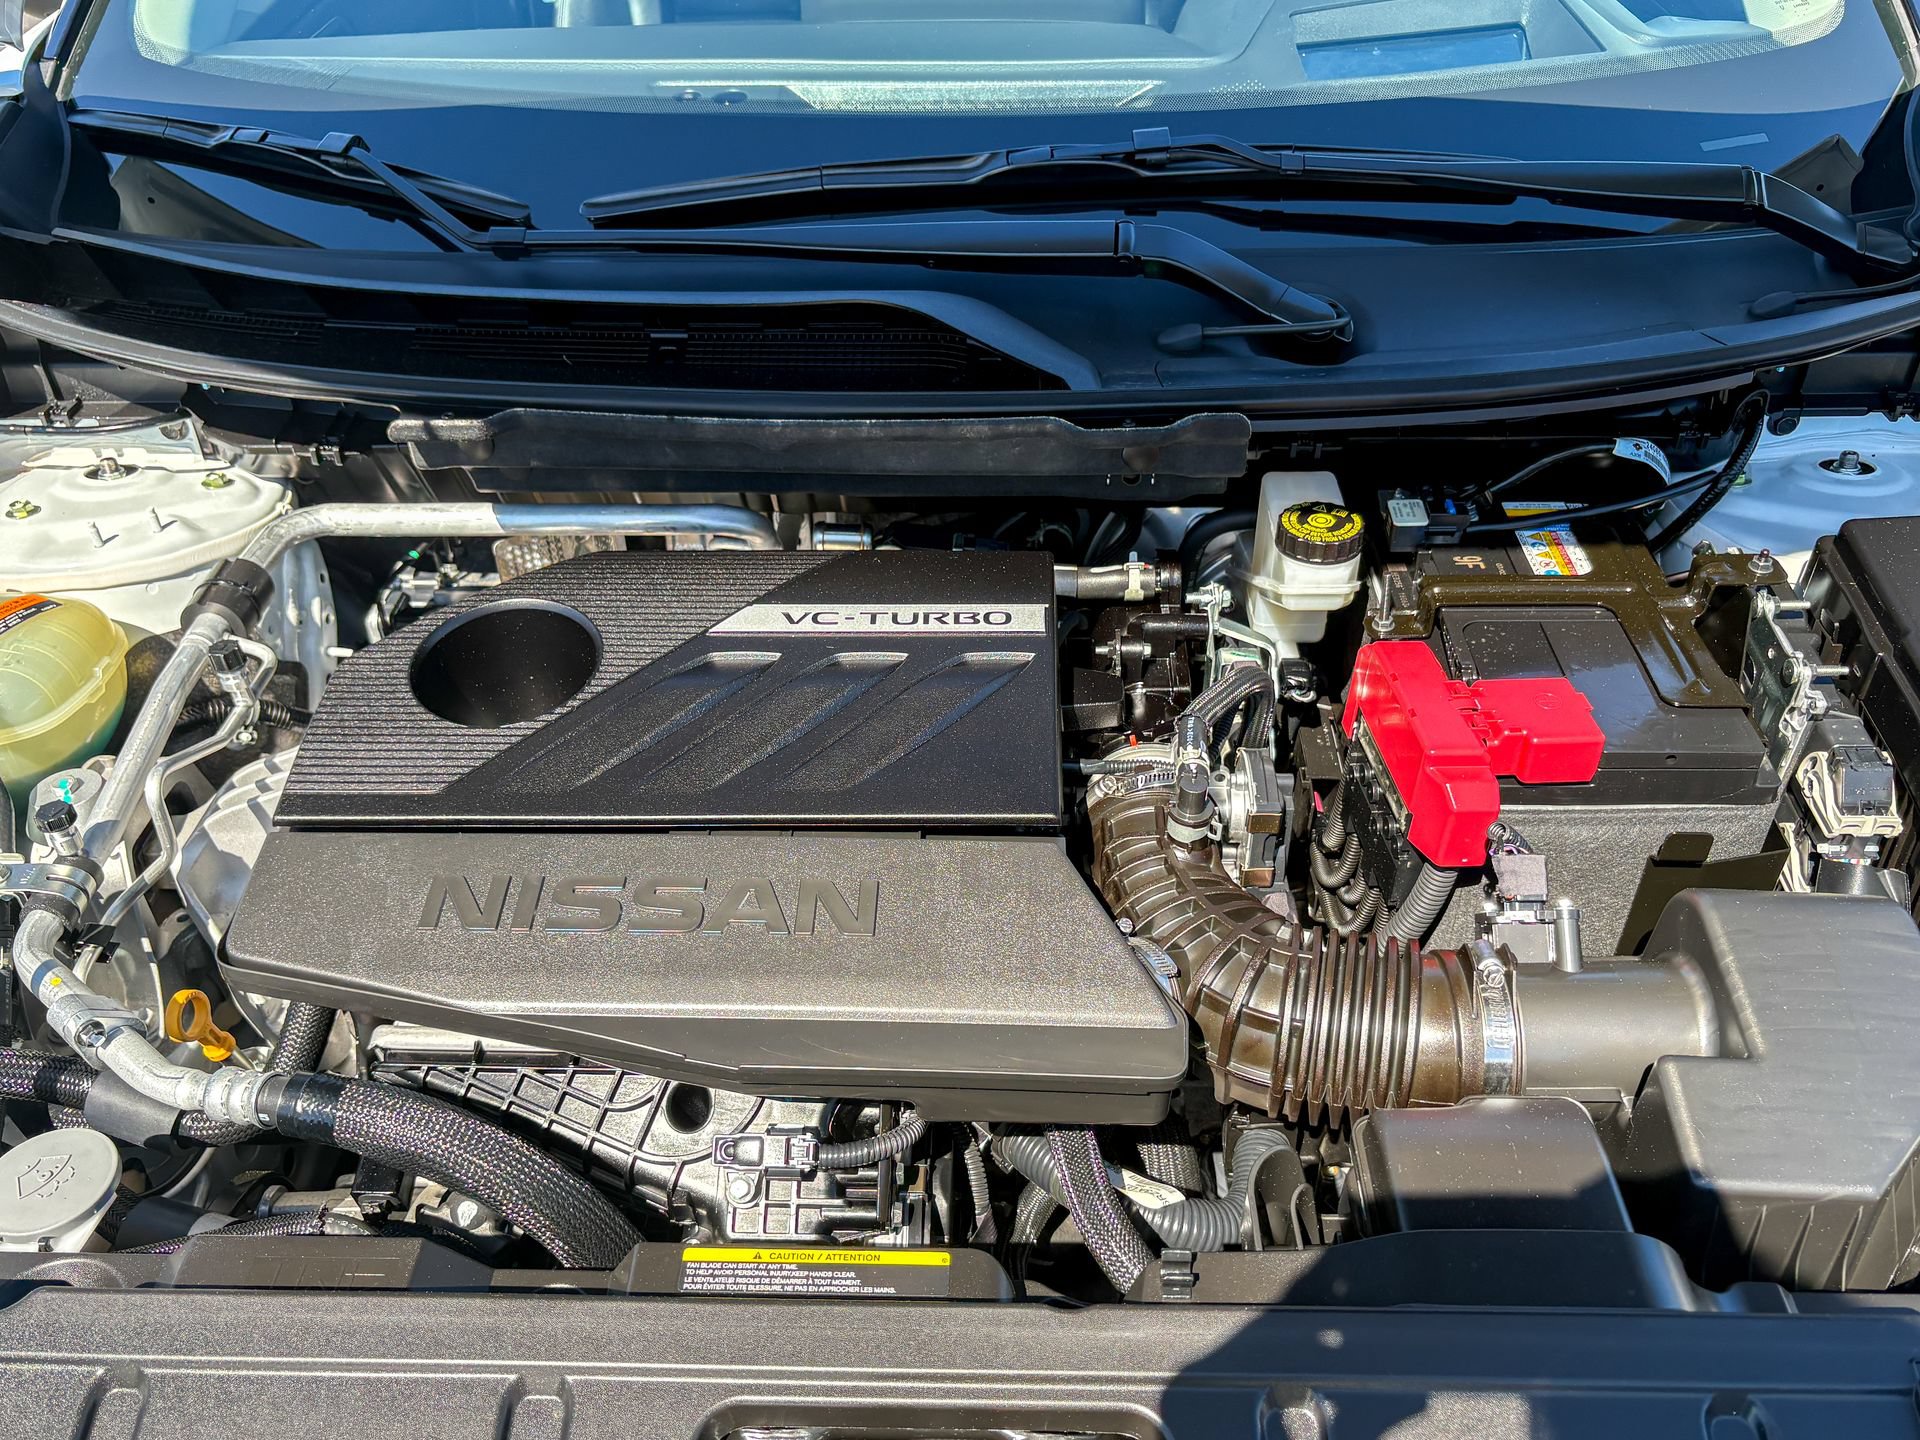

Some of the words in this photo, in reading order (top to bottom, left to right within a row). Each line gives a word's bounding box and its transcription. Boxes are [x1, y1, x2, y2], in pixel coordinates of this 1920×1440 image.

[781, 611, 1012, 625] VC-TURBO
[417, 875, 880, 937] NISSAN
[769, 1252, 814, 1261] CAUTION
[825, 1253, 881, 1262] ATTENTION
[702, 1282, 725, 1290] ÉVITER
[771, 1277, 807, 1285] DÉMARRER
[807, 1277, 813, 1285] À
